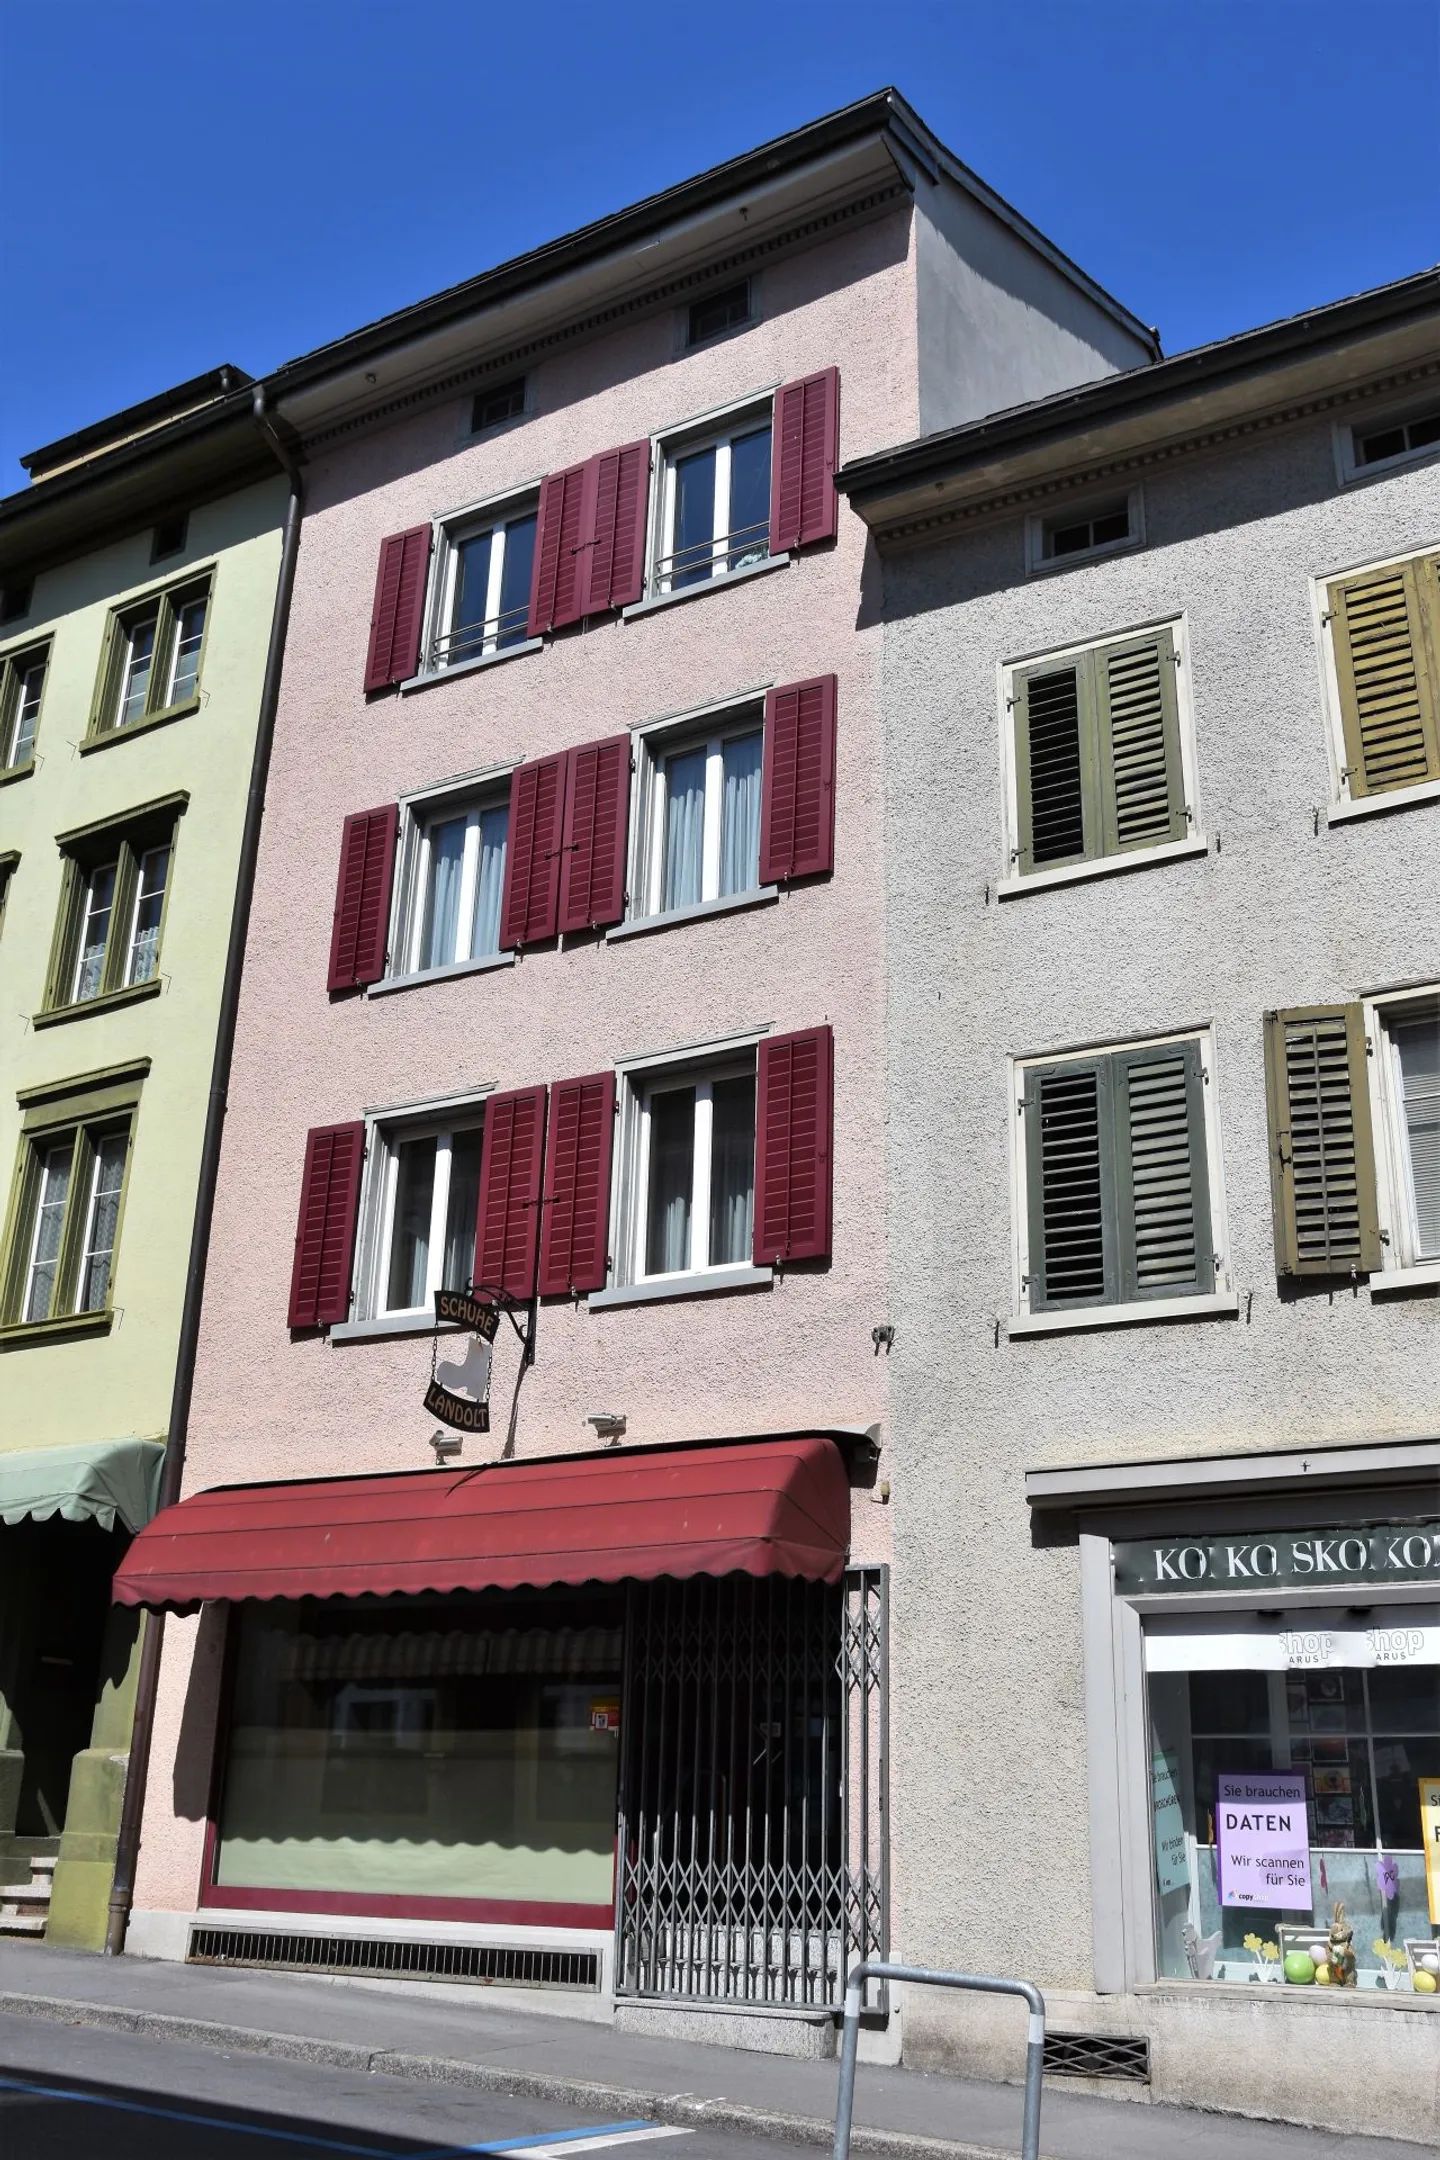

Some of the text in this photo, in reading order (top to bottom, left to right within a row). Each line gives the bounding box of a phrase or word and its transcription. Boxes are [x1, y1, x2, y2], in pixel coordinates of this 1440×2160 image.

[440, 1296, 494, 1334] SCHUHE
[427, 1387, 488, 1428] LANDOLT
[1289, 1652, 1406, 1664] ARUS ARUS
[1224, 1785, 1300, 1798] Sie brauchen
[1226, 1814, 1291, 1832] DATEN
[1231, 1854, 1305, 1869] Wir scannen
[1266, 1873, 1306, 1886] für Sie
